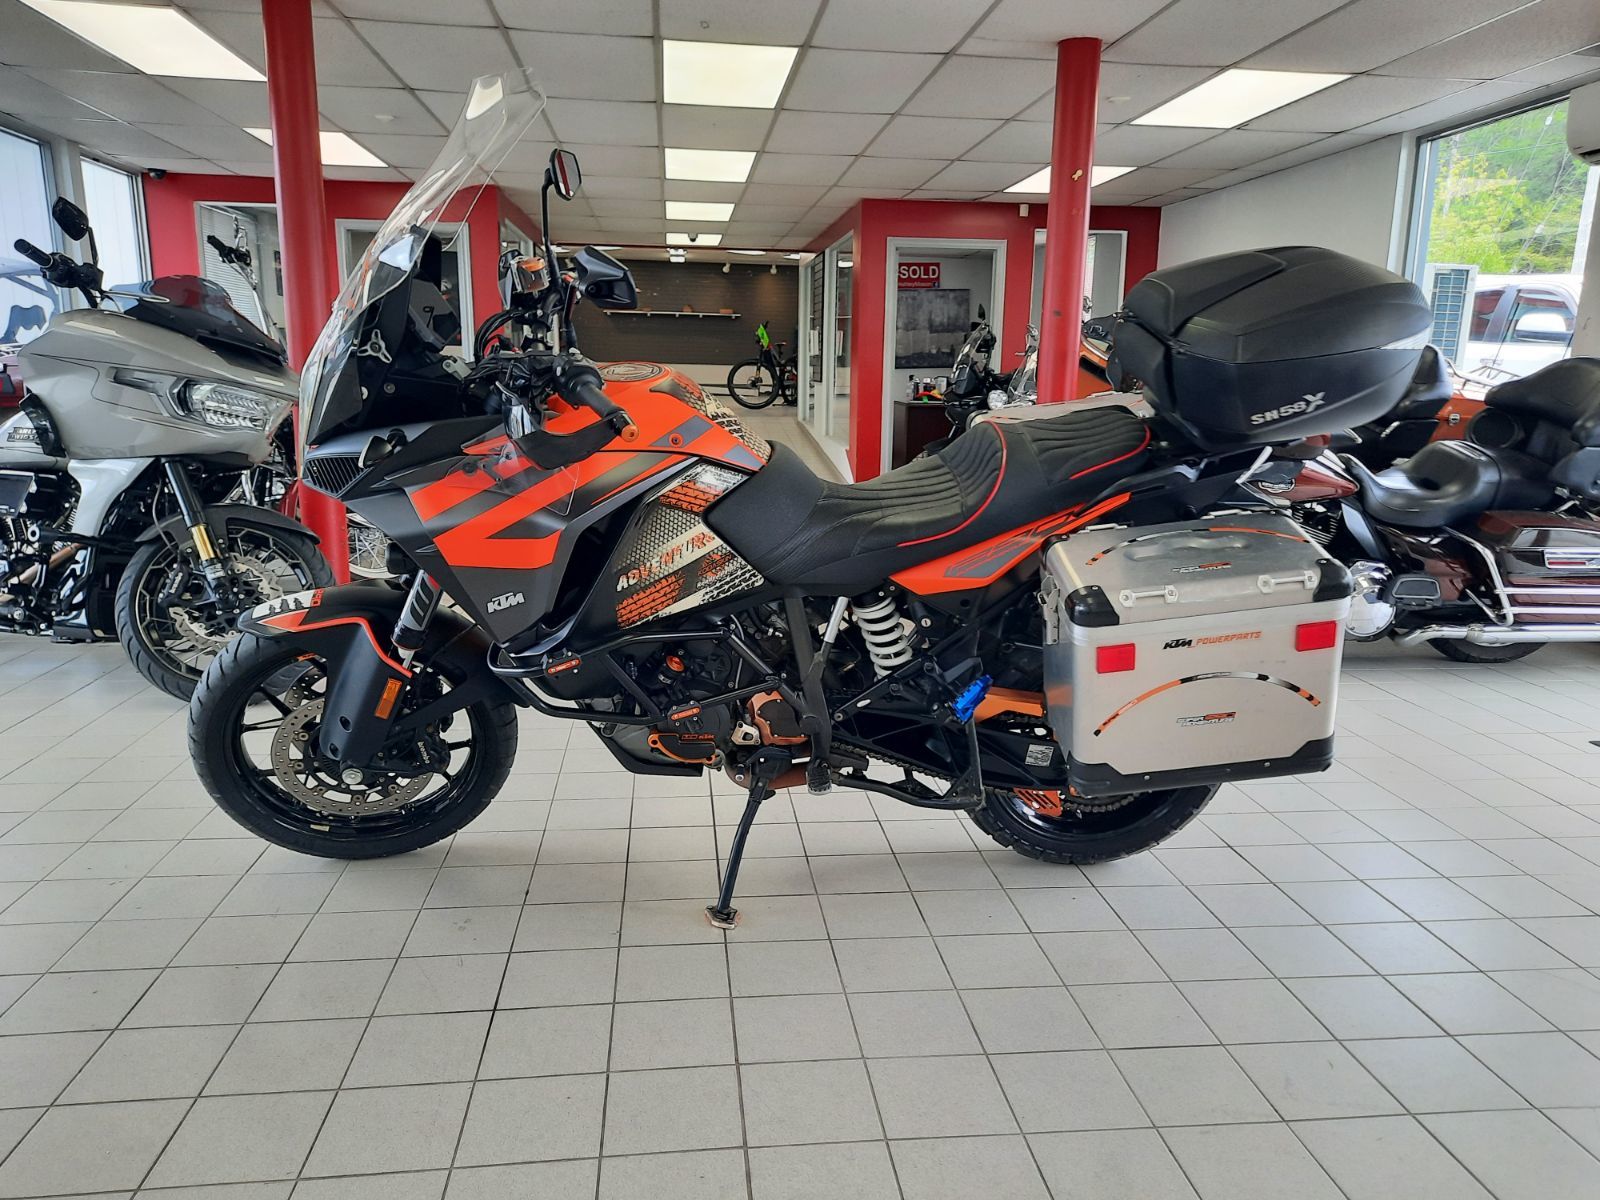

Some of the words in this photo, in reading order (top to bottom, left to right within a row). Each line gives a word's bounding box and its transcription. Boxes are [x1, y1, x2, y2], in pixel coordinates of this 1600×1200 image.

[899, 265, 939, 279] SOLD
[487, 592, 525, 613] KTM
[1163, 638, 1193, 650] KTM
[417, 741, 430, 764] brembo
